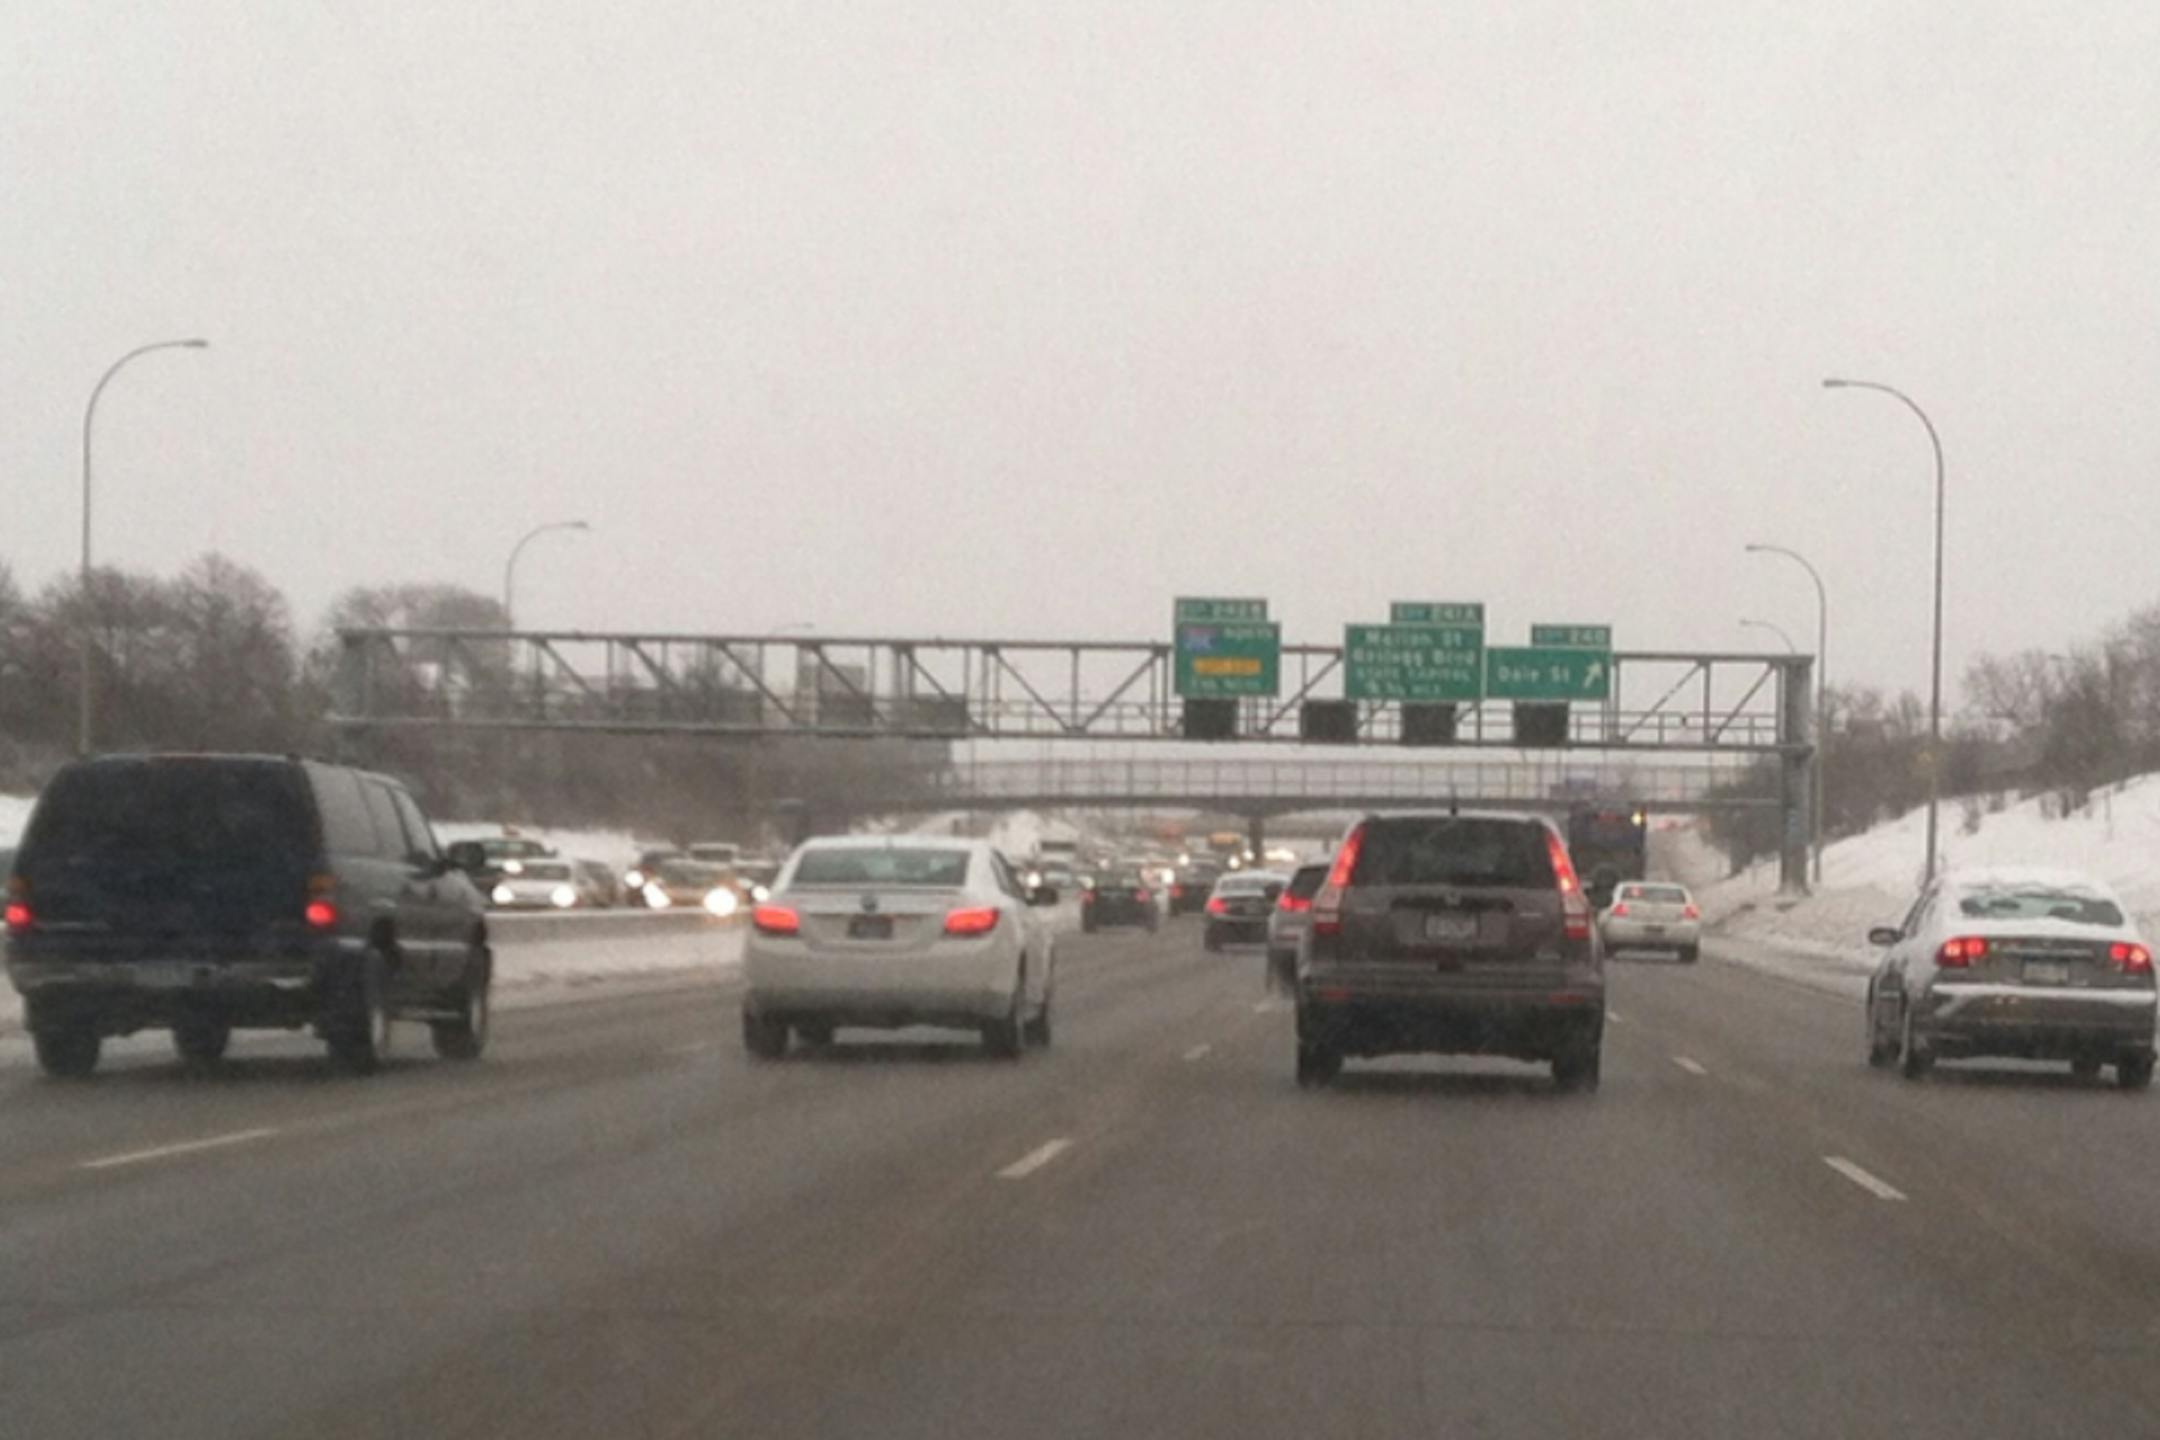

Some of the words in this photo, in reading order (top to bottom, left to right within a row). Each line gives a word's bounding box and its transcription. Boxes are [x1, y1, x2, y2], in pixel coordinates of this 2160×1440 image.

[1442, 630, 1462, 647] St
[1498, 665, 1540, 683] Dale
[1550, 665, 1570, 683] St
